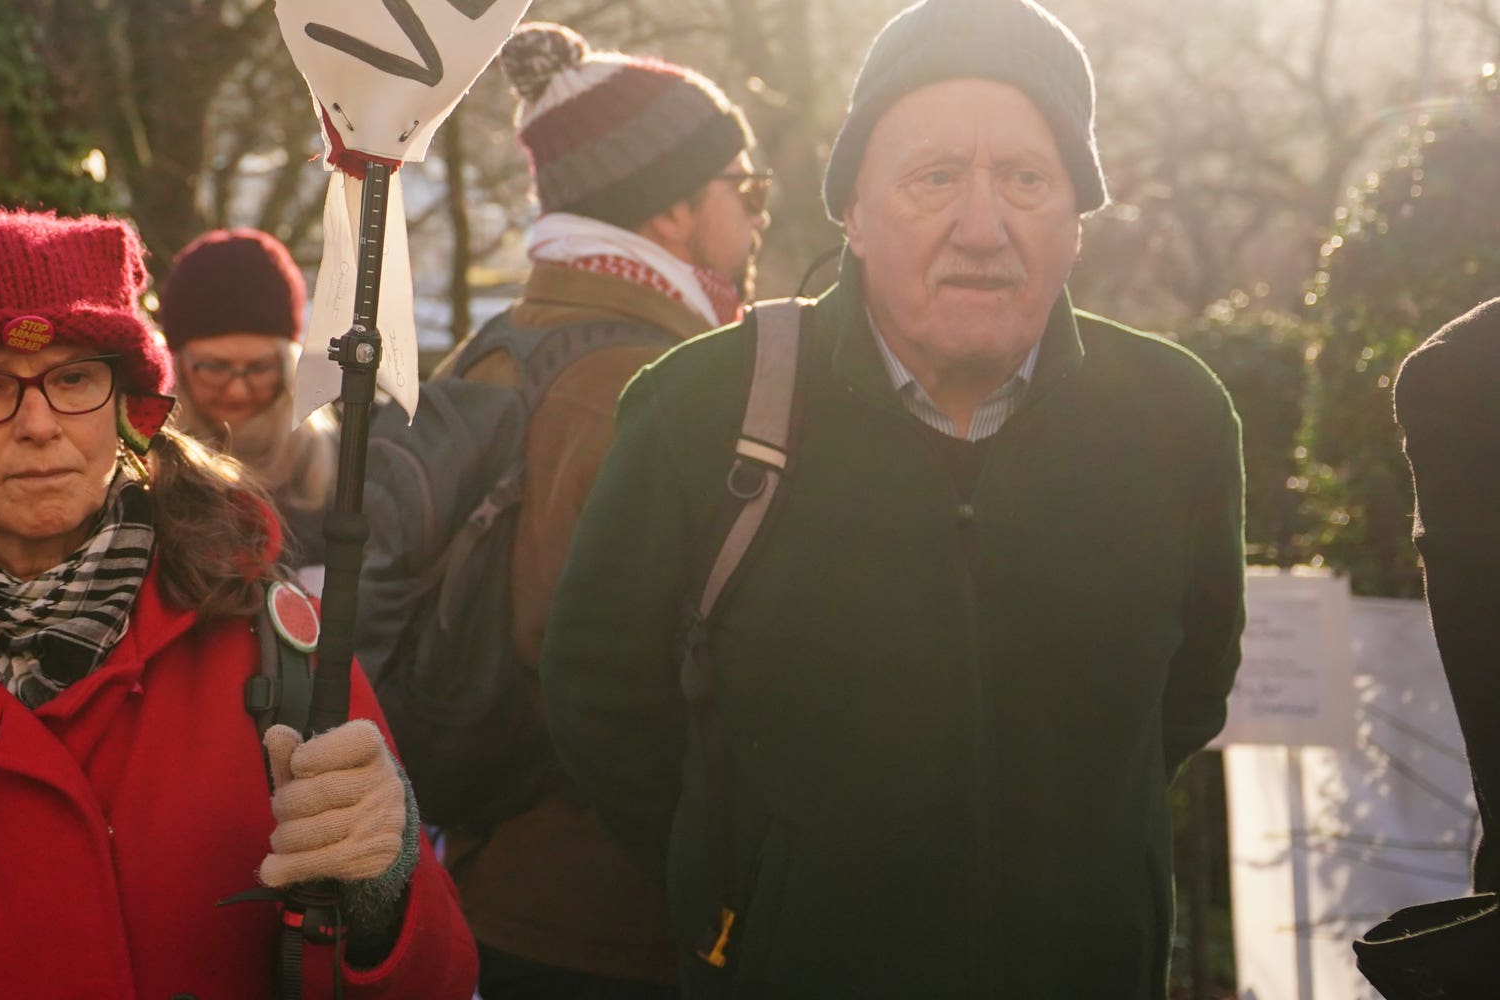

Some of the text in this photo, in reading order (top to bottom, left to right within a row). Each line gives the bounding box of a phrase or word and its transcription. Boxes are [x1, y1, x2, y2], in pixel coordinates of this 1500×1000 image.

[21, 320, 48, 332] STOP
[9, 328, 51, 343] ARMING
[7, 338, 41, 350] ISRAEL
